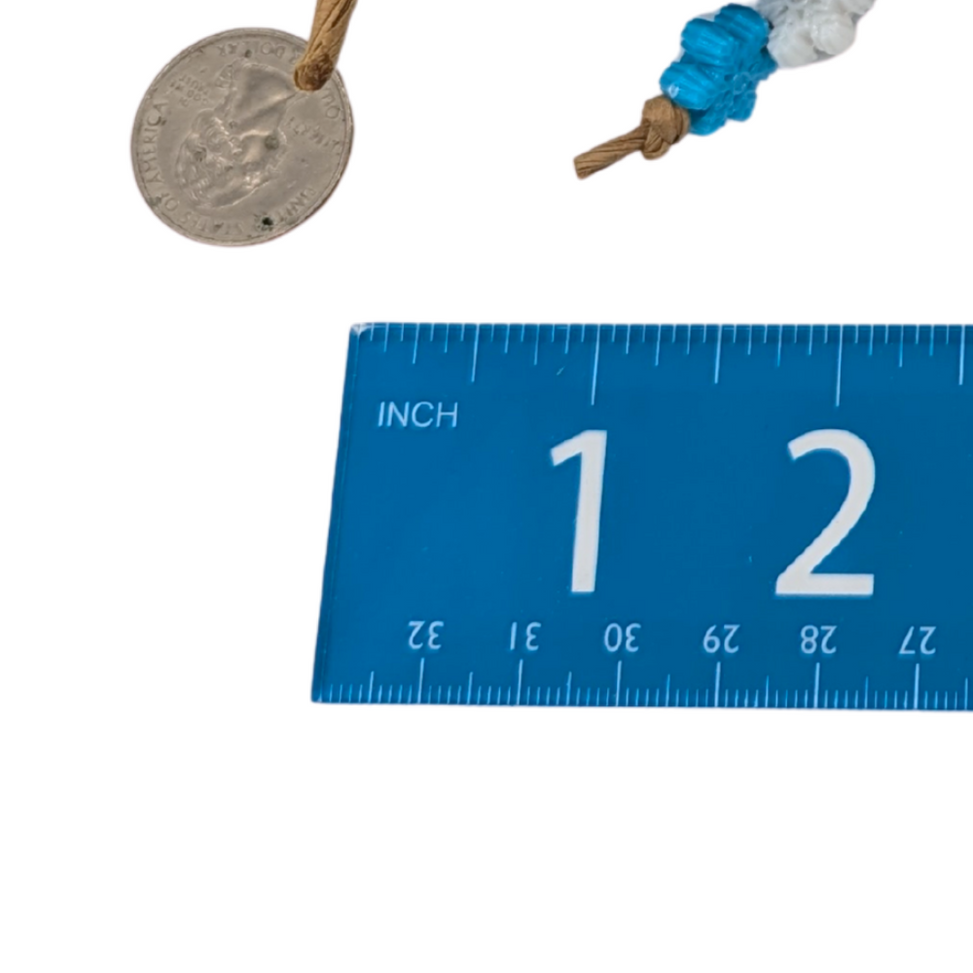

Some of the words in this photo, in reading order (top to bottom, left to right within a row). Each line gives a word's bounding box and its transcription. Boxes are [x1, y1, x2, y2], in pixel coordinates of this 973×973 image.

[144, 97, 170, 185] AMERICA
[376, 401, 459, 428] INCH
[550, 429, 608, 593] 1
[775, 428, 876, 596] 2
[408, 621, 443, 650] 32
[510, 622, 541, 651] 31
[604, 623, 640, 652] 30
[703, 624, 739, 653] 29
[801, 625, 836, 654] 28
[899, 626, 935, 655] 27
